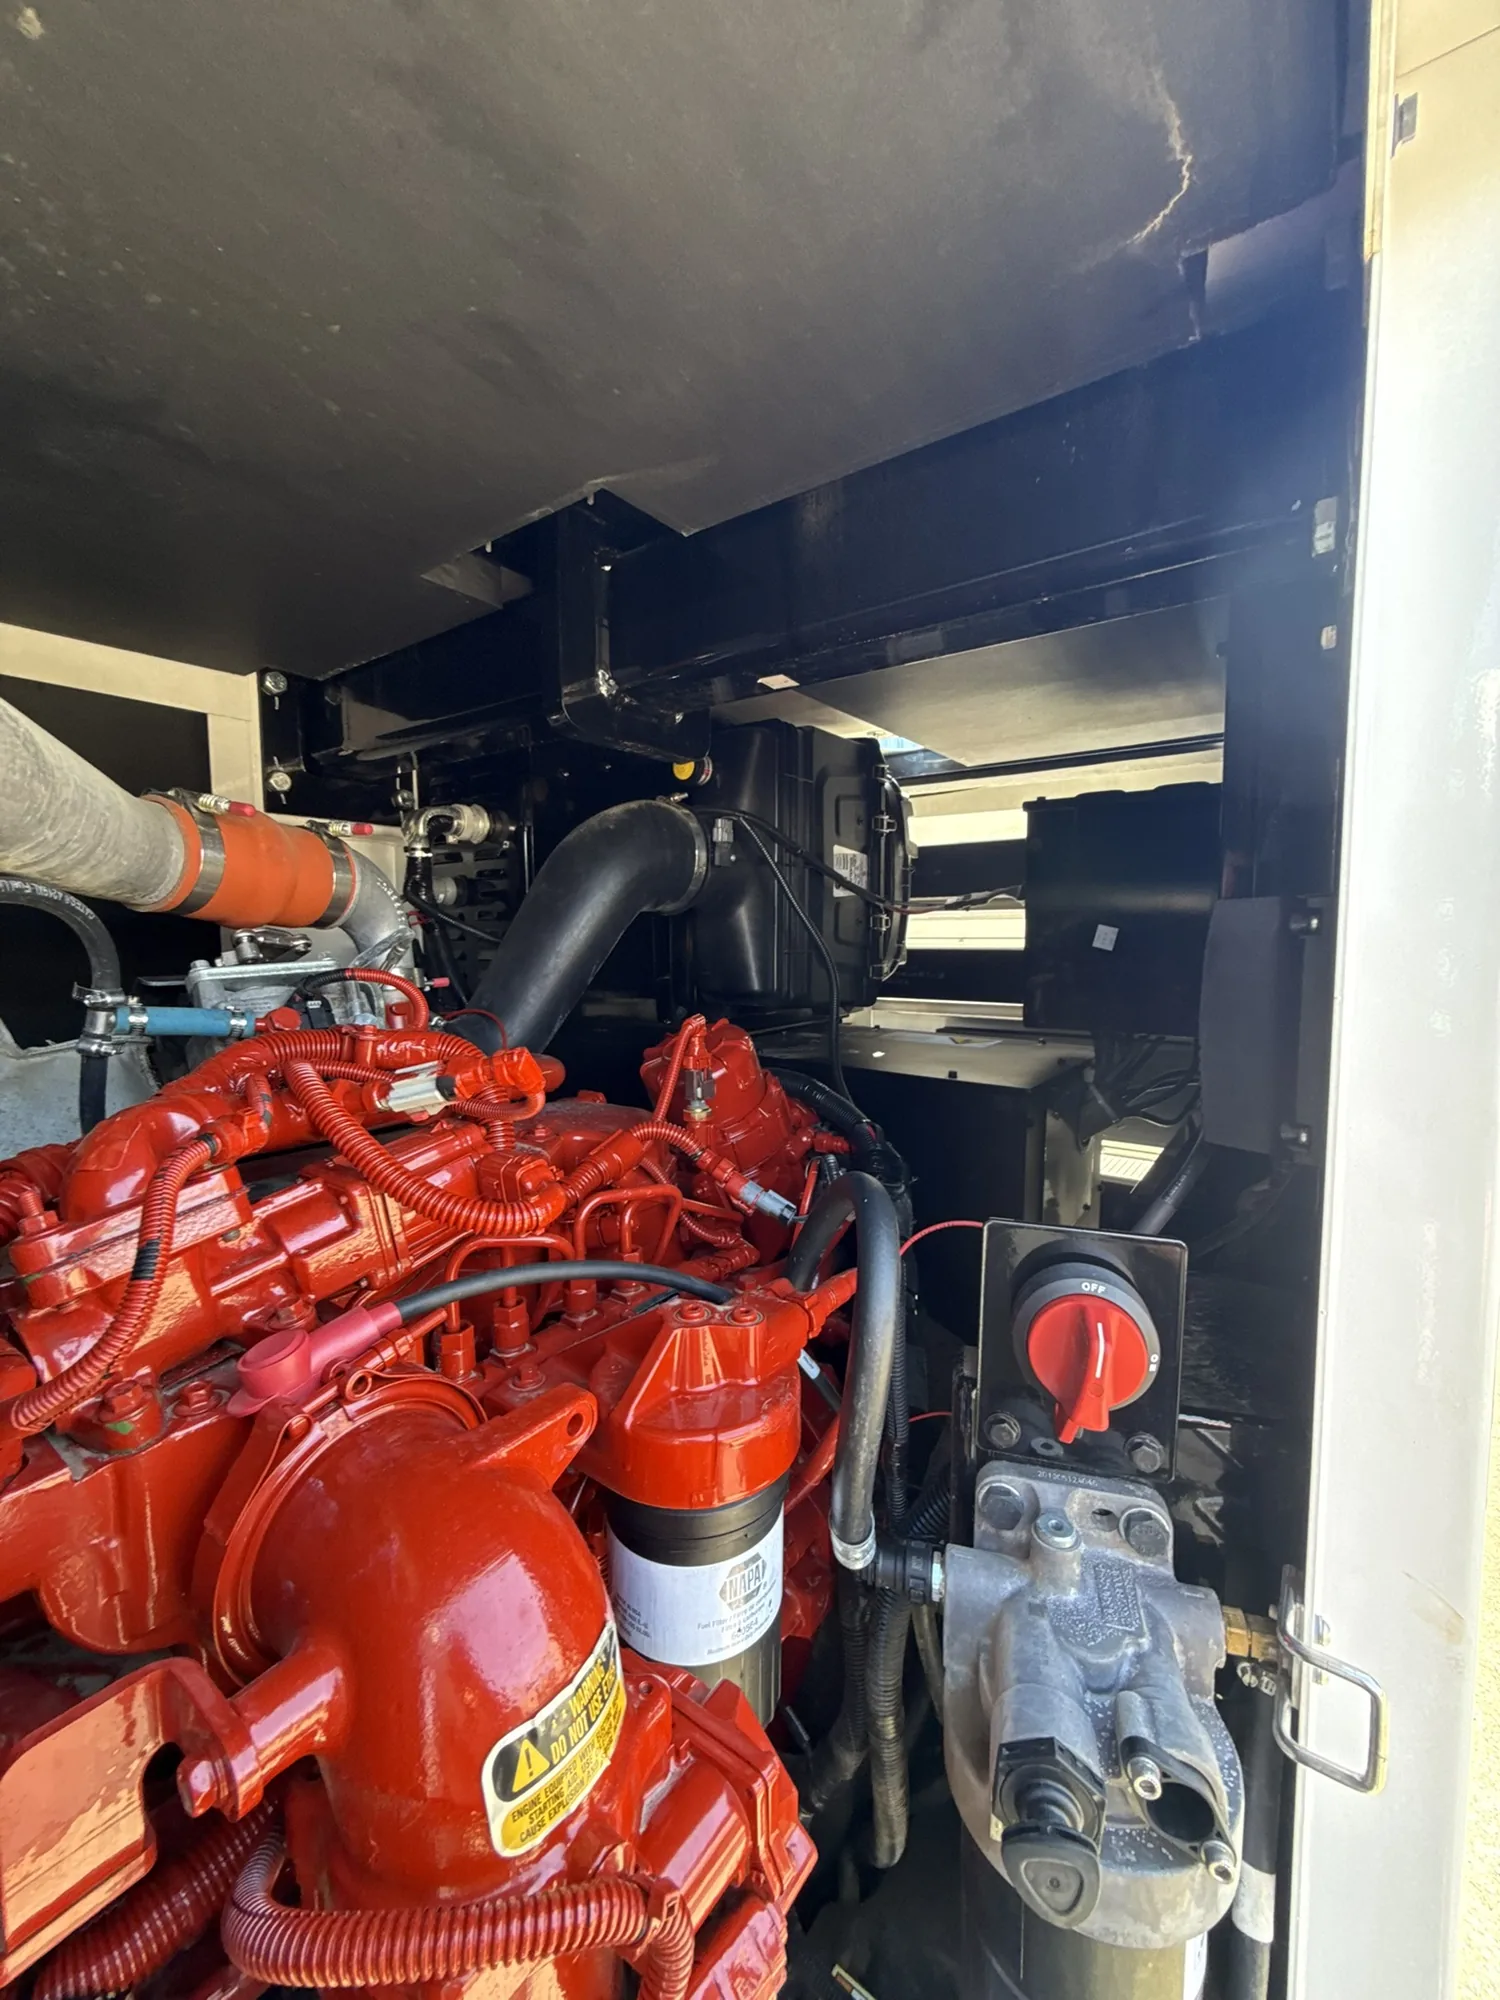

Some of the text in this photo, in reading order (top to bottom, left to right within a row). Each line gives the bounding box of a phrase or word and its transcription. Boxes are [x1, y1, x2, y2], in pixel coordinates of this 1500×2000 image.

[1081, 1282, 1106, 1294] OFF
[1149, 1353, 1159, 1372] ON
[728, 1562, 763, 1601] NAPA
[569, 1658, 605, 1718] WARNING
[550, 1734, 568, 1765] DO
[568, 1709, 589, 1748] NOT
[588, 1687, 604, 1722] USE
[512, 1794, 542, 1823] ENGINE
[544, 1760, 577, 1798] EQUIPPED
[520, 1816, 546, 1842] CAUSE
[548, 1779, 585, 1821] EXPLOSION
[529, 1787, 565, 1825] STARTING
